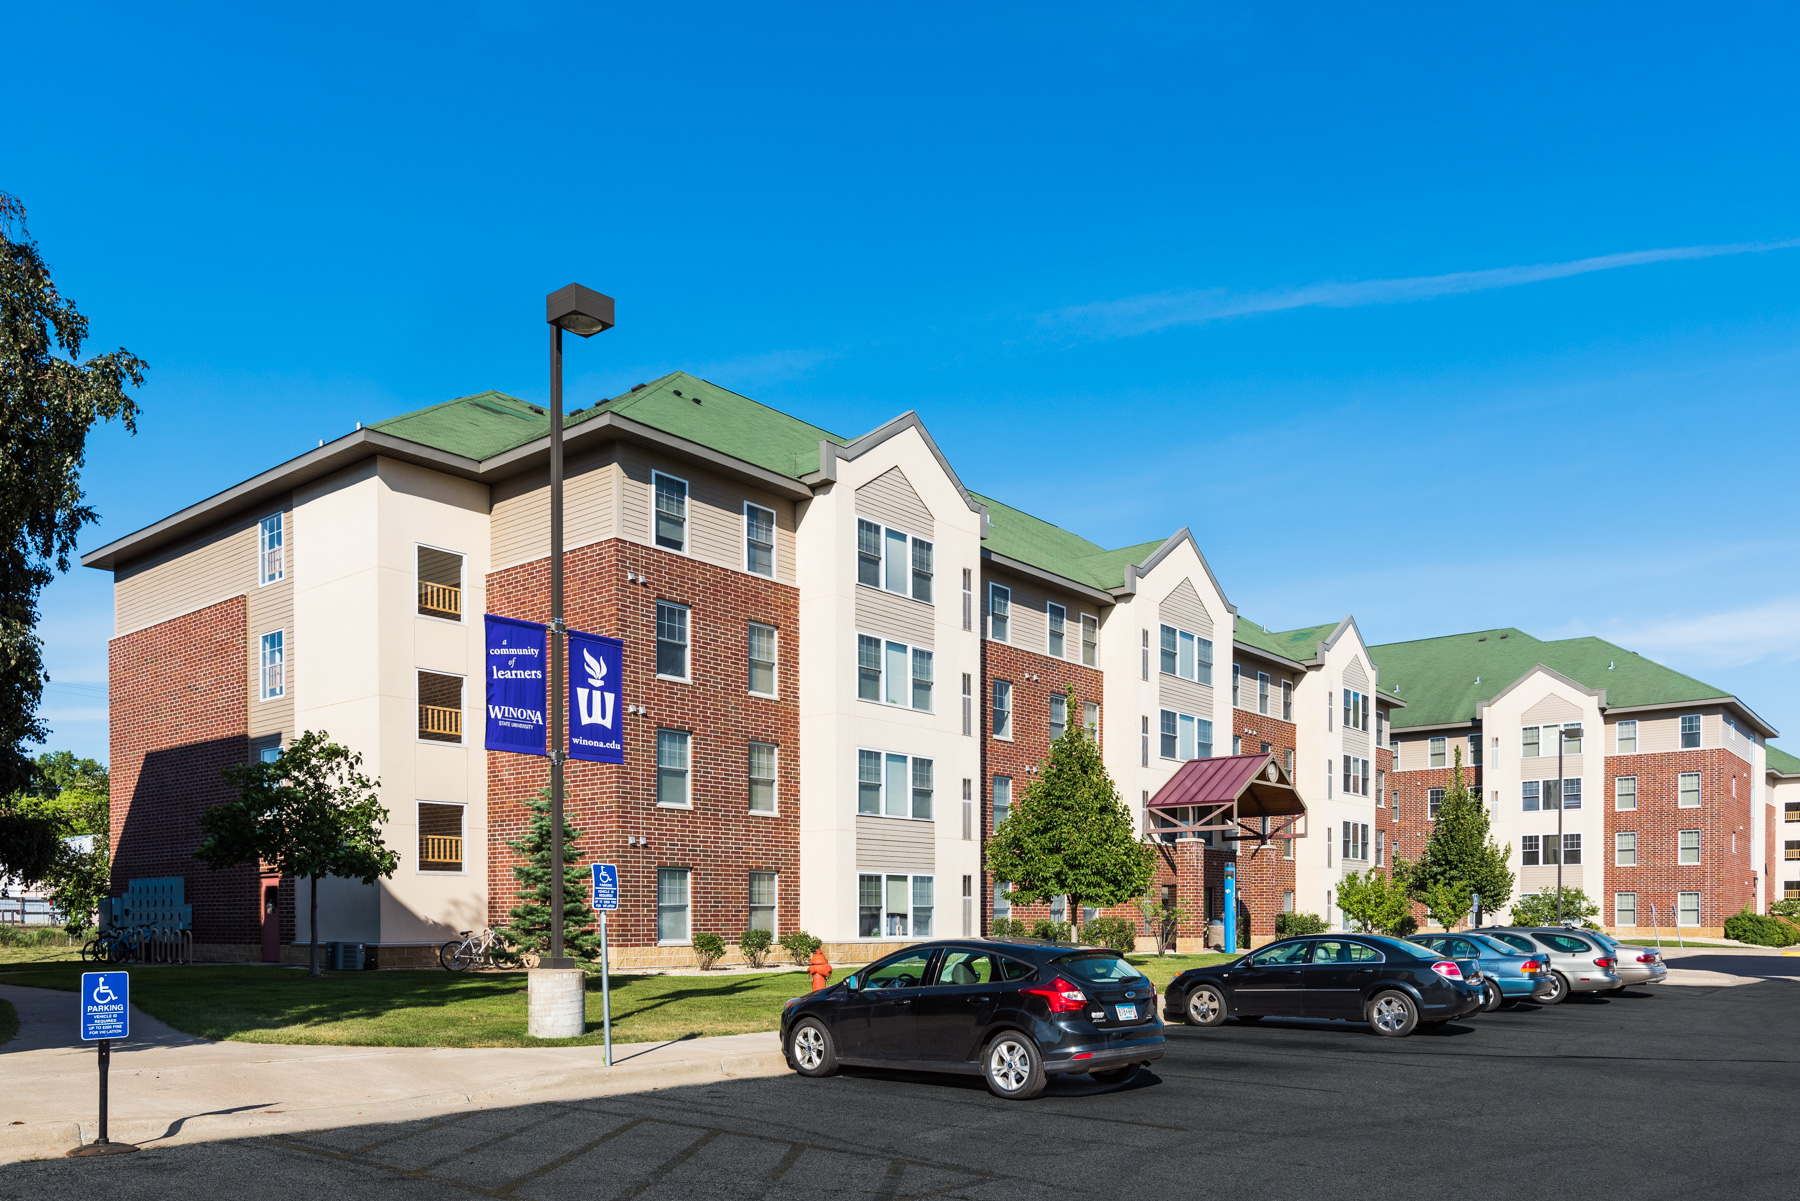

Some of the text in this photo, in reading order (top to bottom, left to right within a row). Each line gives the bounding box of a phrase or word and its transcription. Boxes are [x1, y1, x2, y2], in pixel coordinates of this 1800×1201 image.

[490, 646, 539, 657] community
[508, 657, 516, 668] of
[492, 666, 542, 679] learners
[488, 705, 543, 725] WINONA
[572, 737, 621, 749] winona.edu
[87, 1004, 123, 1012] PARKING
